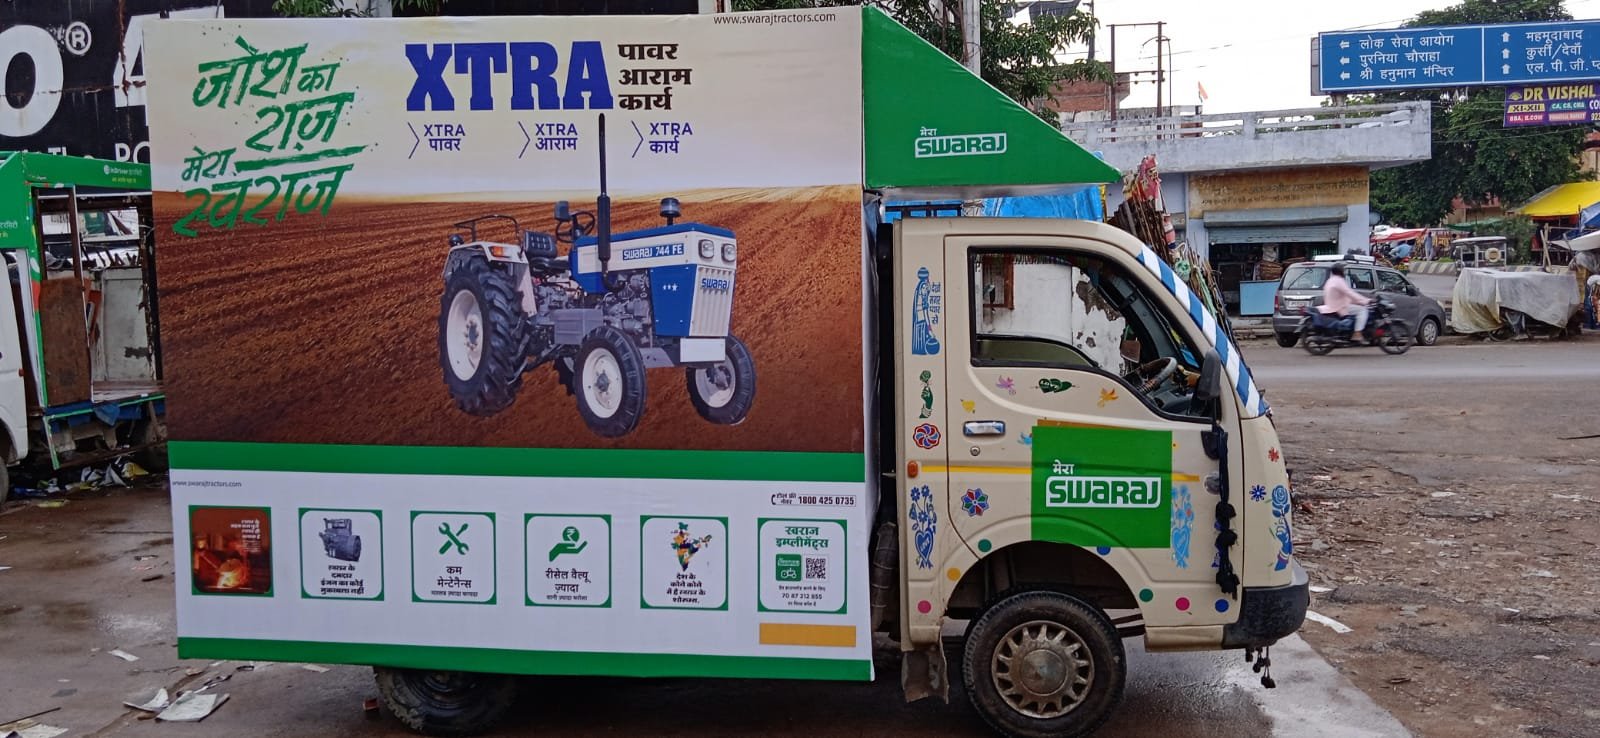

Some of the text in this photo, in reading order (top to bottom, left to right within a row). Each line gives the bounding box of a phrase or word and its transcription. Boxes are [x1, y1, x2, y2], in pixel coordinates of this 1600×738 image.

[713, 13, 836, 25] www.swarajtractors.com
[1359, 32, 1454, 49] लोक सेवा आयोग
[1525, 29, 1584, 44] महमूदाबाद
[617, 43, 679, 60] पावर
[1359, 51, 1398, 67] पुरनिया
[192, 36, 341, 109] जोश का
[405, 40, 614, 112] XTRA
[618, 68, 693, 85] आराम
[1360, 66, 1373, 80] श्री
[1379, 68, 1416, 82] हनुमान
[618, 86, 673, 110] कार्य
[1523, 84, 1596, 101] DR VISHAL
[424, 124, 465, 137] XTRA
[535, 123, 578, 136] XTRA
[649, 122, 693, 136] XTRA
[920, 126, 937, 137] मेरा
[429, 138, 461, 152] पावर
[535, 137, 578, 151] आराम
[649, 136, 680, 154] कार्य
[181, 146, 237, 182] मेरा
[655, 246, 670, 256] 744
[672, 244, 683, 254] FE
[1053, 459, 1075, 475] मेरा
[798, 496, 817, 504] 1800
[818, 496, 833, 505] 425
[835, 496, 855, 505] 0735
[784, 526, 819, 536] स्वराज
[446, 566, 462, 575] कम
[545, 567, 569, 579] रीसेल
